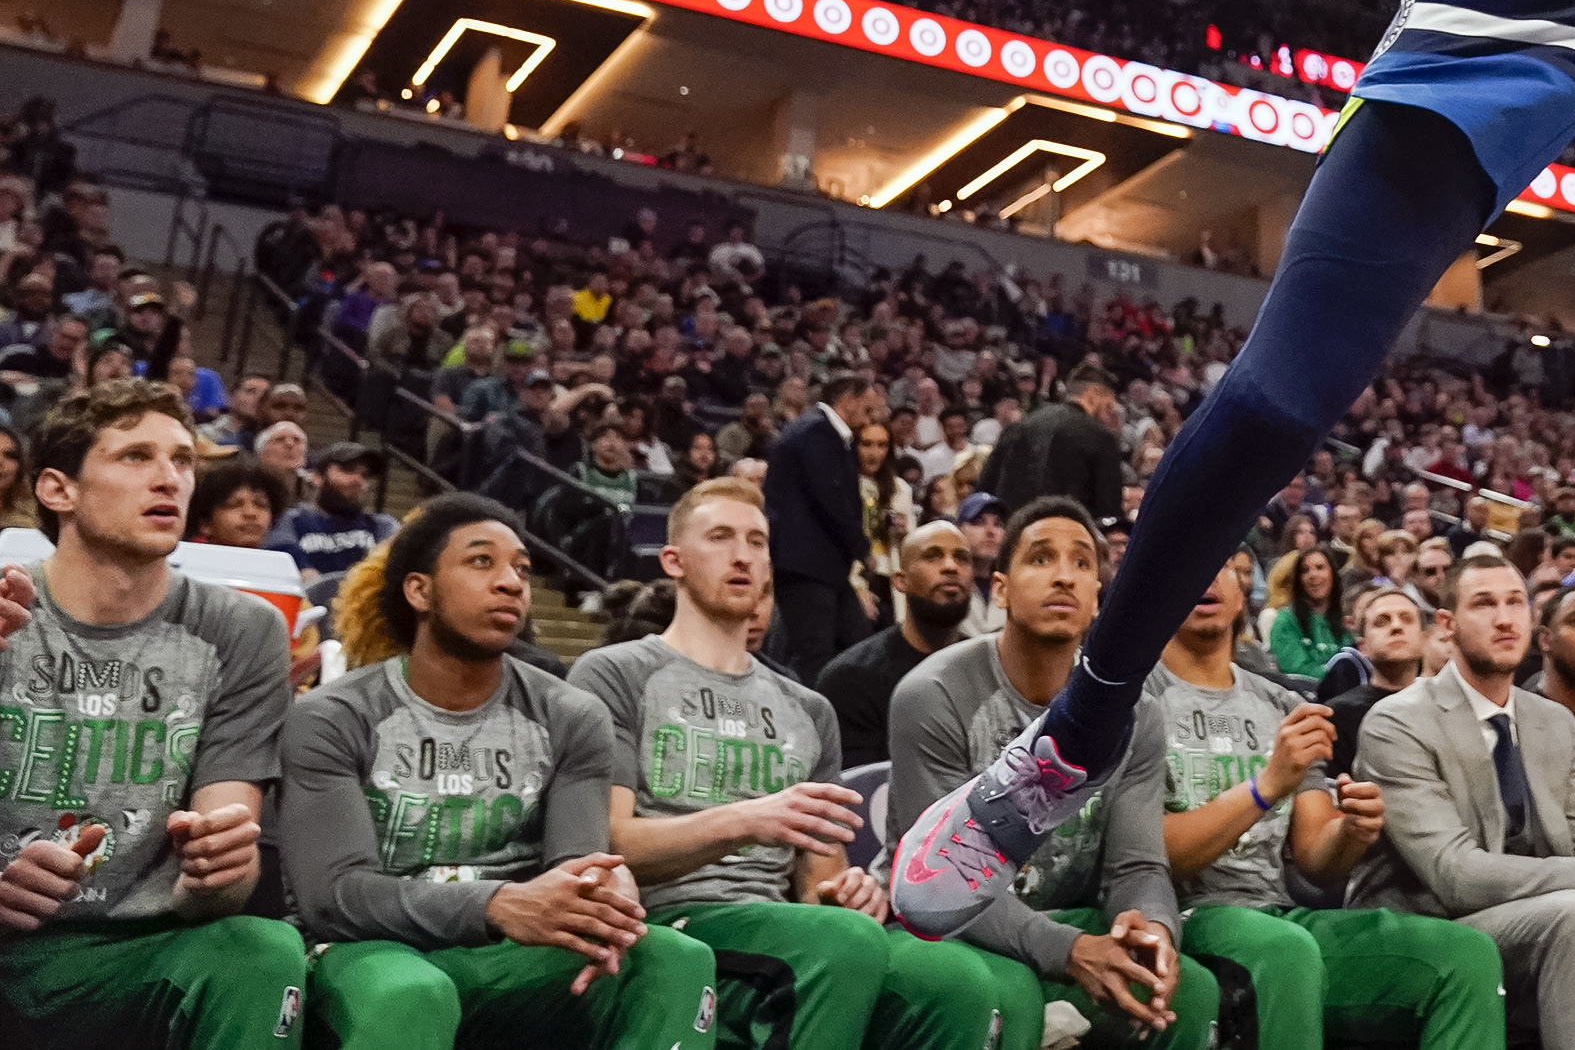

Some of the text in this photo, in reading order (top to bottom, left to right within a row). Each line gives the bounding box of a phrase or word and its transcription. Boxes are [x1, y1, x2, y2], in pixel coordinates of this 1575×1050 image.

[28, 650, 166, 713] SOMOS
[77, 693, 119, 717] LOS
[680, 687, 777, 740] SOMOS
[717, 717, 748, 738] LOS
[1175, 709, 1260, 751] SOMOS
[394, 737, 513, 790] SOMOS
[436, 773, 475, 796] LOS
